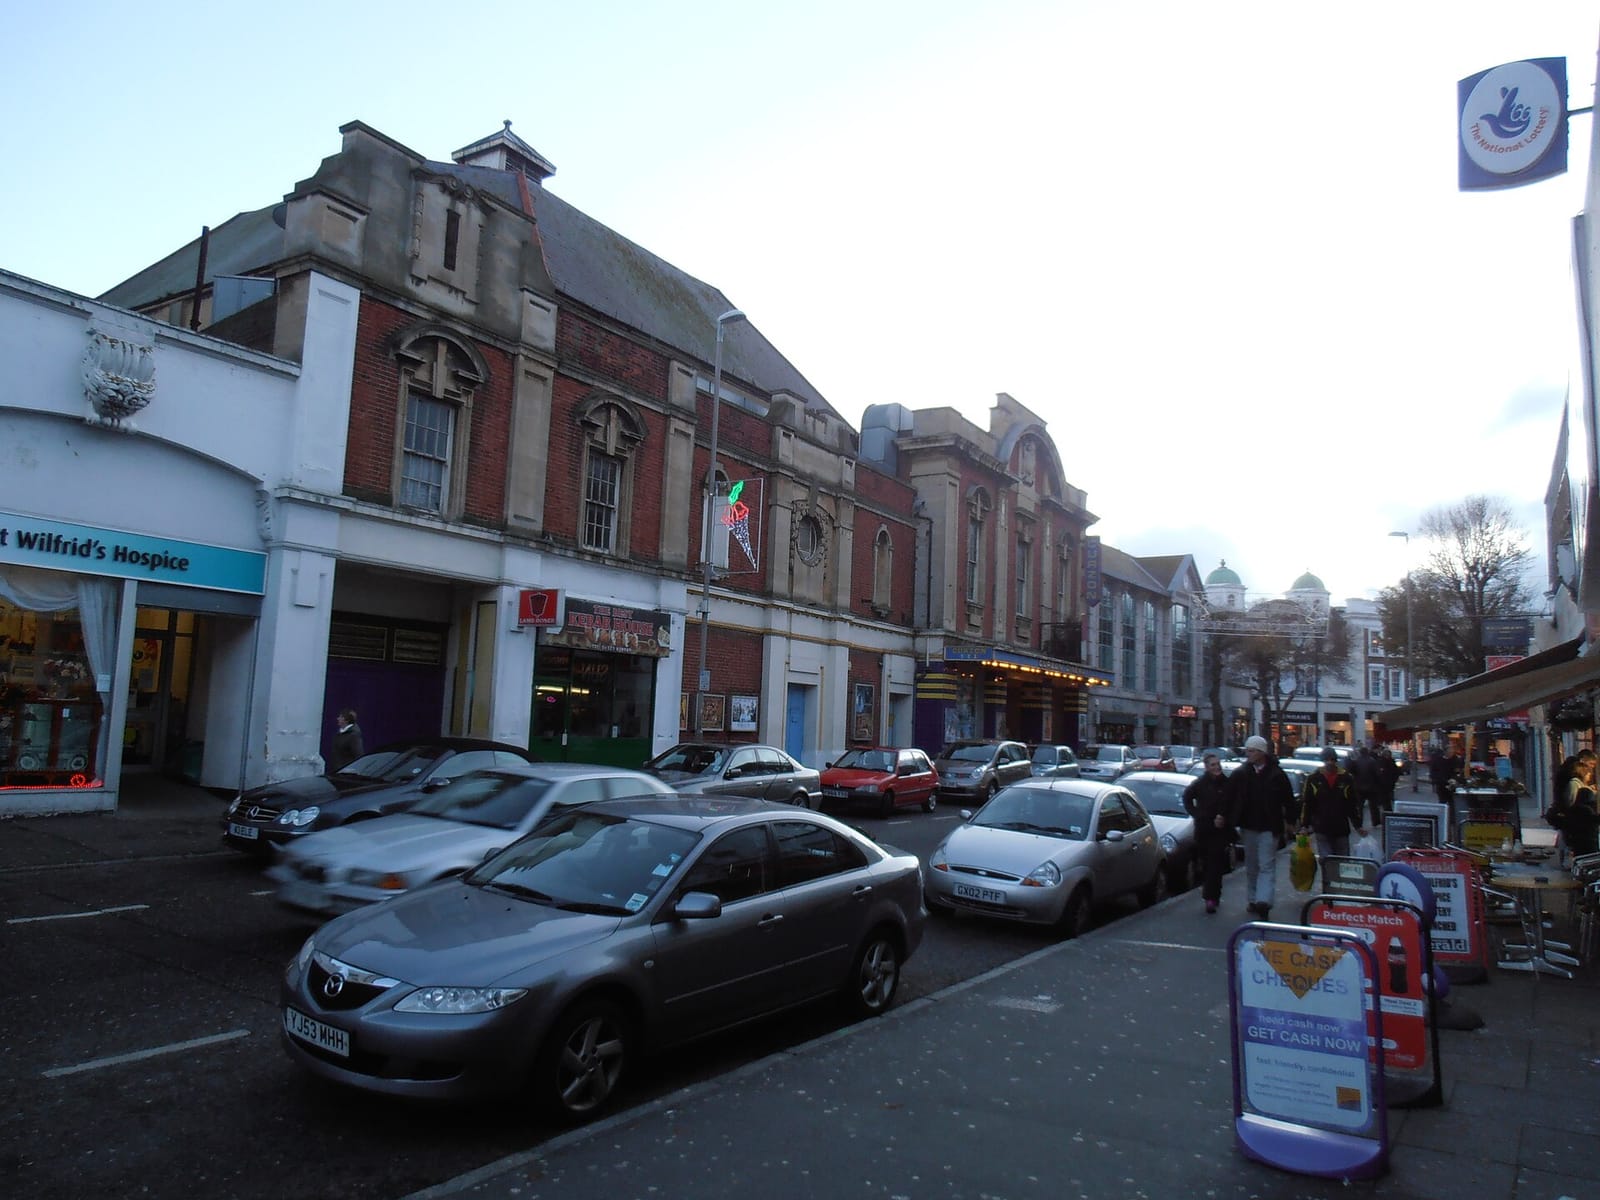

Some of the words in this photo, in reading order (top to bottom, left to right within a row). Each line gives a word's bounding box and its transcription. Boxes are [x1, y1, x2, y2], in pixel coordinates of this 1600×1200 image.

[1470, 123, 1480, 141] The
[1477, 139, 1525, 154] National
[1524, 106, 1550, 144] Lottery
[16, 530, 106, 560] Wilfrid's
[113, 545, 190, 572] Hospice
[568, 612, 610, 630] KEBAB
[612, 617, 654, 637] HOUSE
[957, 885, 981, 898] GX02
[982, 889, 1001, 902] PTF
[1323, 911, 1365, 923] Perfect
[1367, 914, 1404, 926] Match
[1430, 939, 1465, 951] erald
[1252, 970, 1349, 996] CHEQUES
[290, 1011, 317, 1039] YJ53
[319, 1025, 344, 1051] MHH
[1259, 1014, 1285, 1026] need
[1287, 1018, 1314, 1030] cash
[1247, 1025, 1277, 1041] GET
[1279, 1030, 1321, 1048] CASH
[1324, 1037, 1362, 1054] NOW
